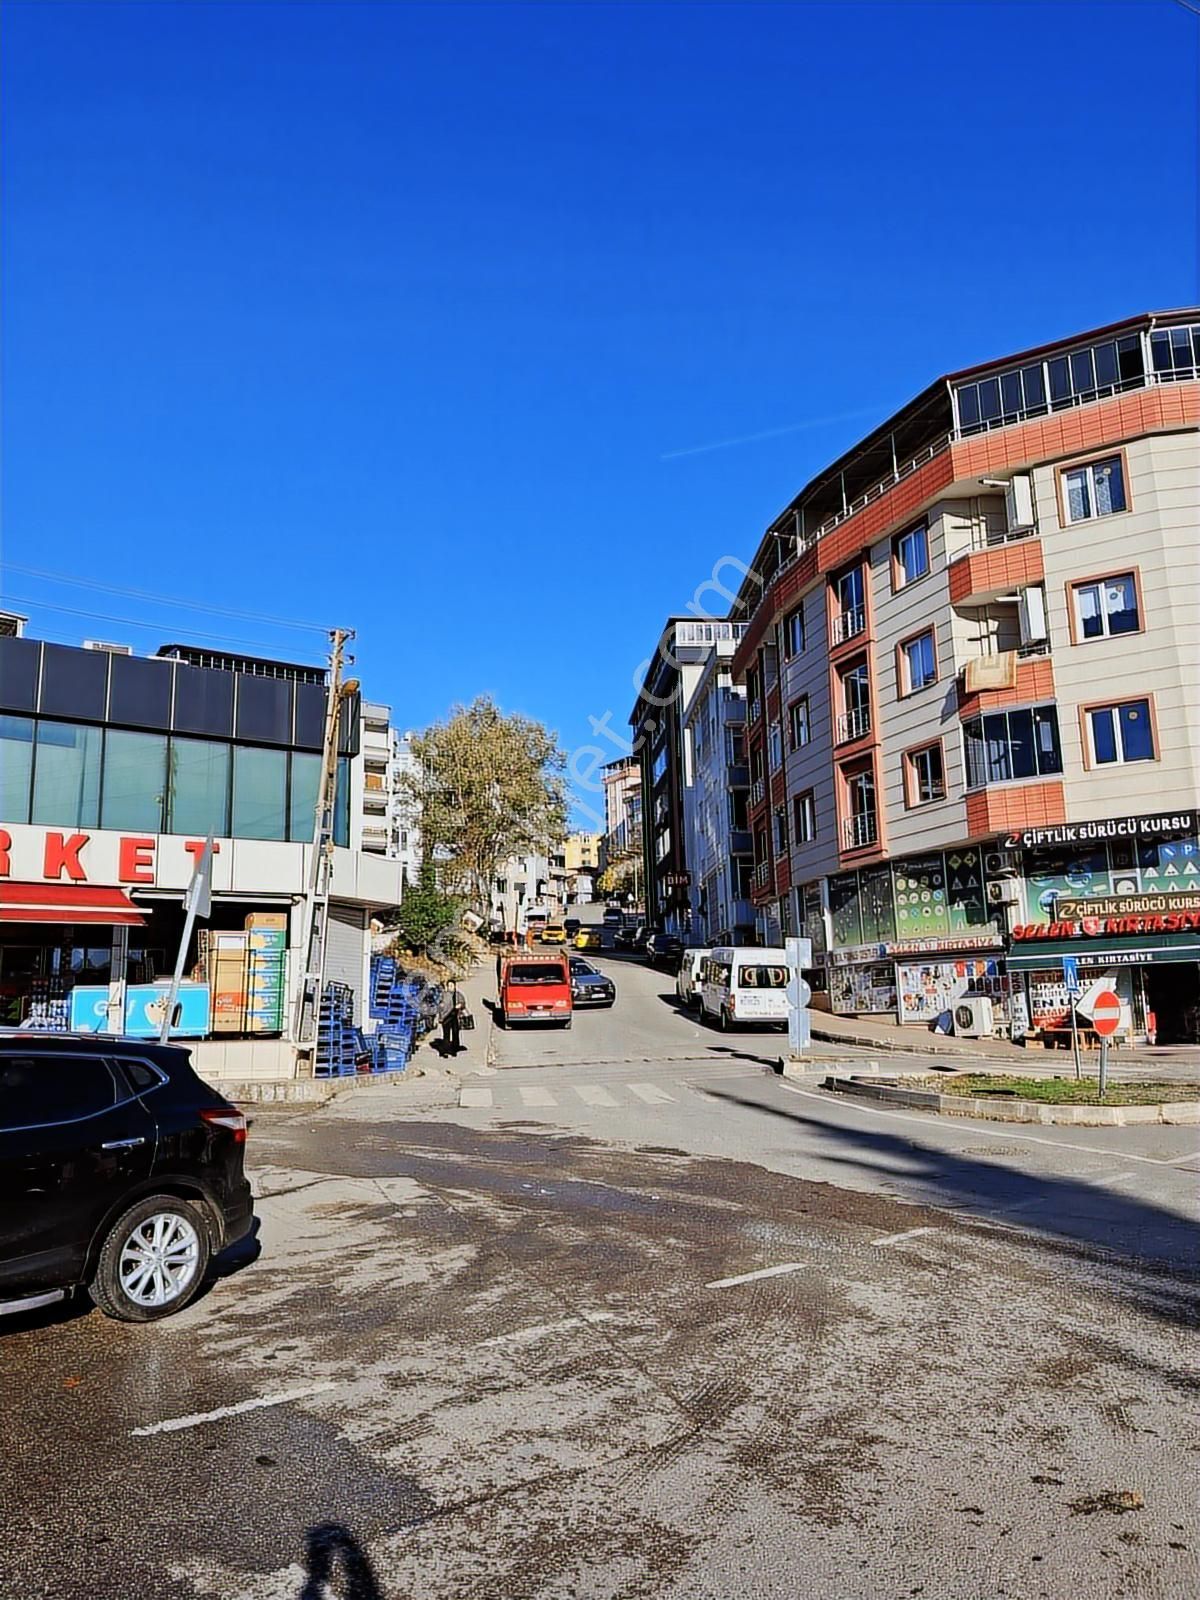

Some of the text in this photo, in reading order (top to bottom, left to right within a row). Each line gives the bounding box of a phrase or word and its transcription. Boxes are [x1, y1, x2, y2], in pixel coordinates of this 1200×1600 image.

[1023, 815, 1191, 848] ÇİFTLİK SÜRÜCÜ KURSU
[0, 829, 220, 883] KET
[1076, 899, 1118, 917] ÇİFTLİK
[1119, 897, 1166, 912] SÜRÜCÜ
[1012, 920, 1074, 940] SELEN
[1098, 952, 1153, 963] KIRTASİYE
